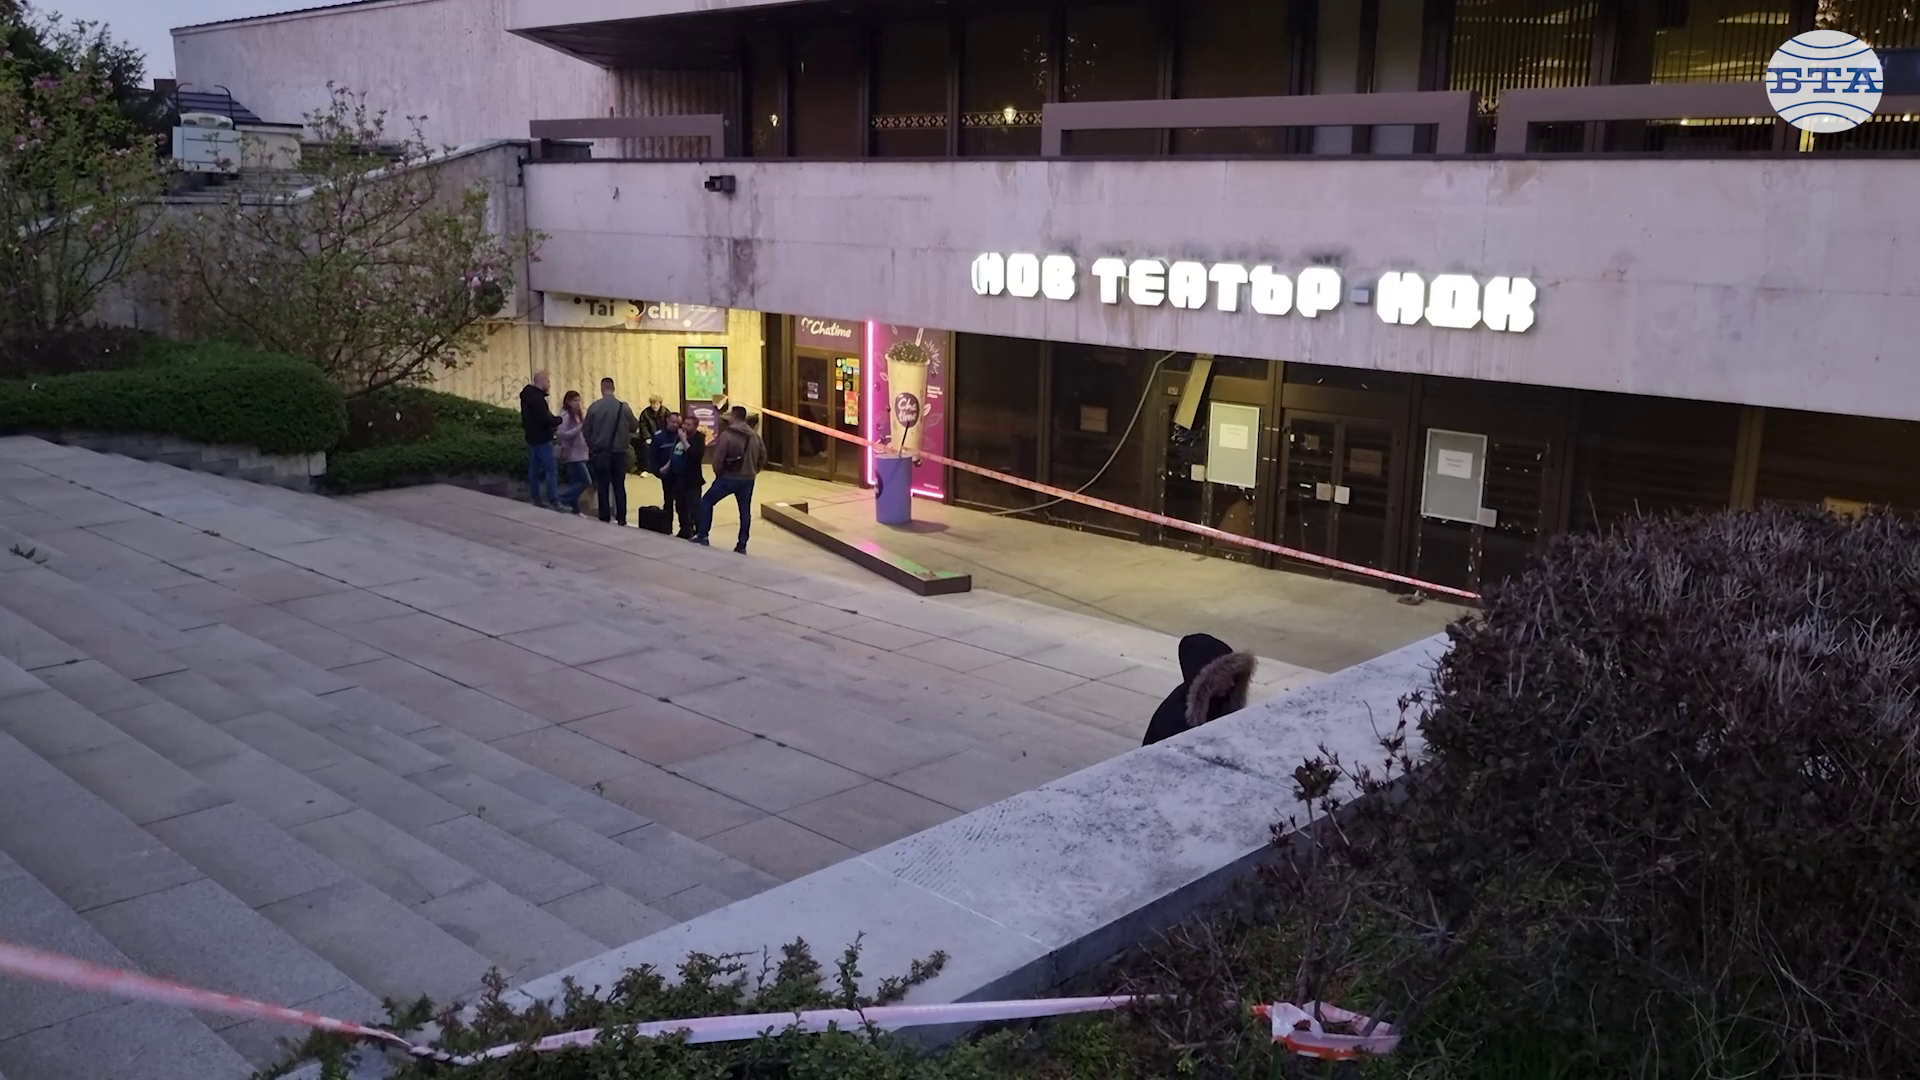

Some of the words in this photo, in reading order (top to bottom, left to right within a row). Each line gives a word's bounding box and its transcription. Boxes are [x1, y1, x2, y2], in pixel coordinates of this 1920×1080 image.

[971, 251, 1077, 301] НОВ
[1091, 258, 1342, 318] ТЕАТЪР
[1375, 271, 1537, 333] НДК
[585, 299, 615, 317] Tai
[647, 302, 680, 320] chi
[810, 319, 852, 338] Chatime
